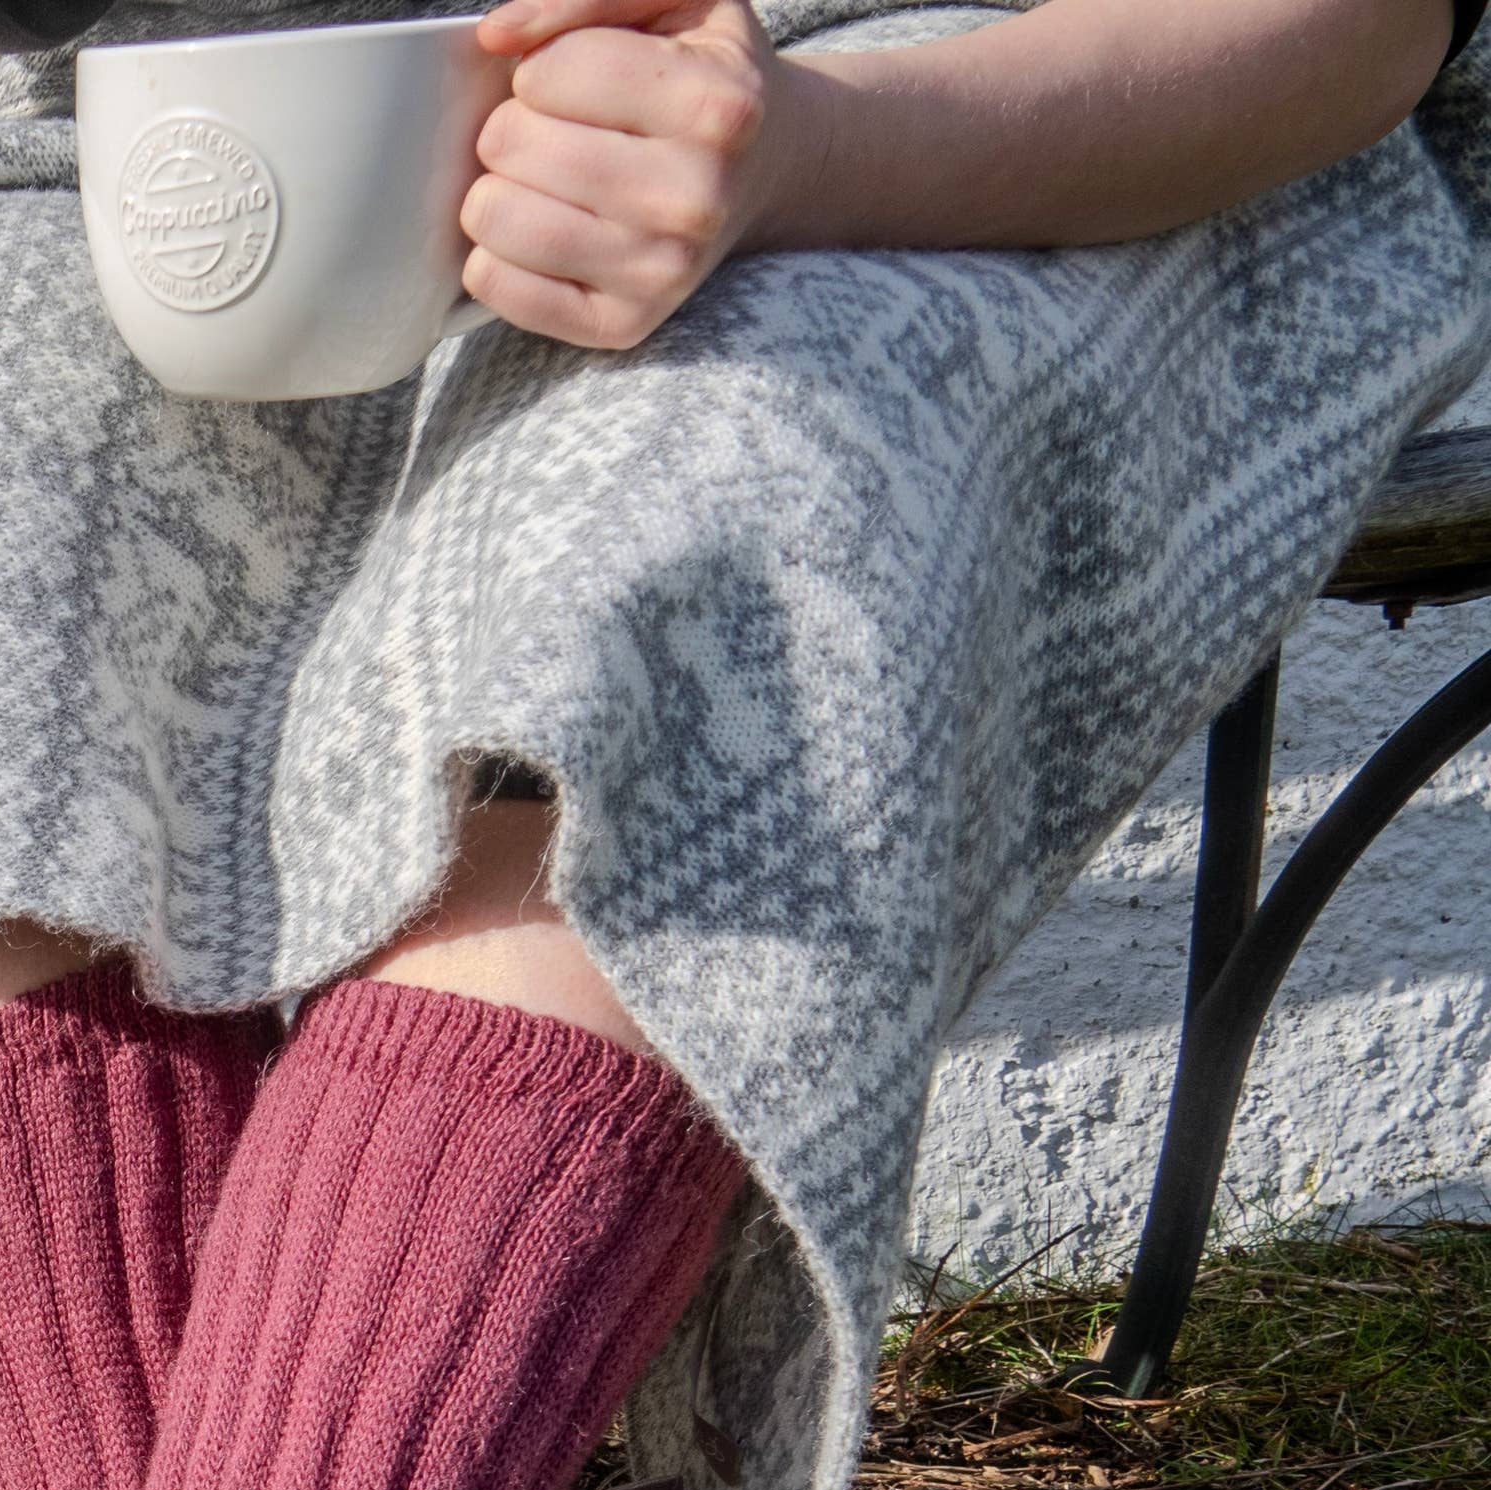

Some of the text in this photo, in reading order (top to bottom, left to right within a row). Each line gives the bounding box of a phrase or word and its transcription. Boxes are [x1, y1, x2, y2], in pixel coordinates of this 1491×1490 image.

[184, 122, 255, 181] BREWED
[122, 184, 271, 241] Cappuccino
[133, 226, 267, 300] PREMIUM QUALITY
